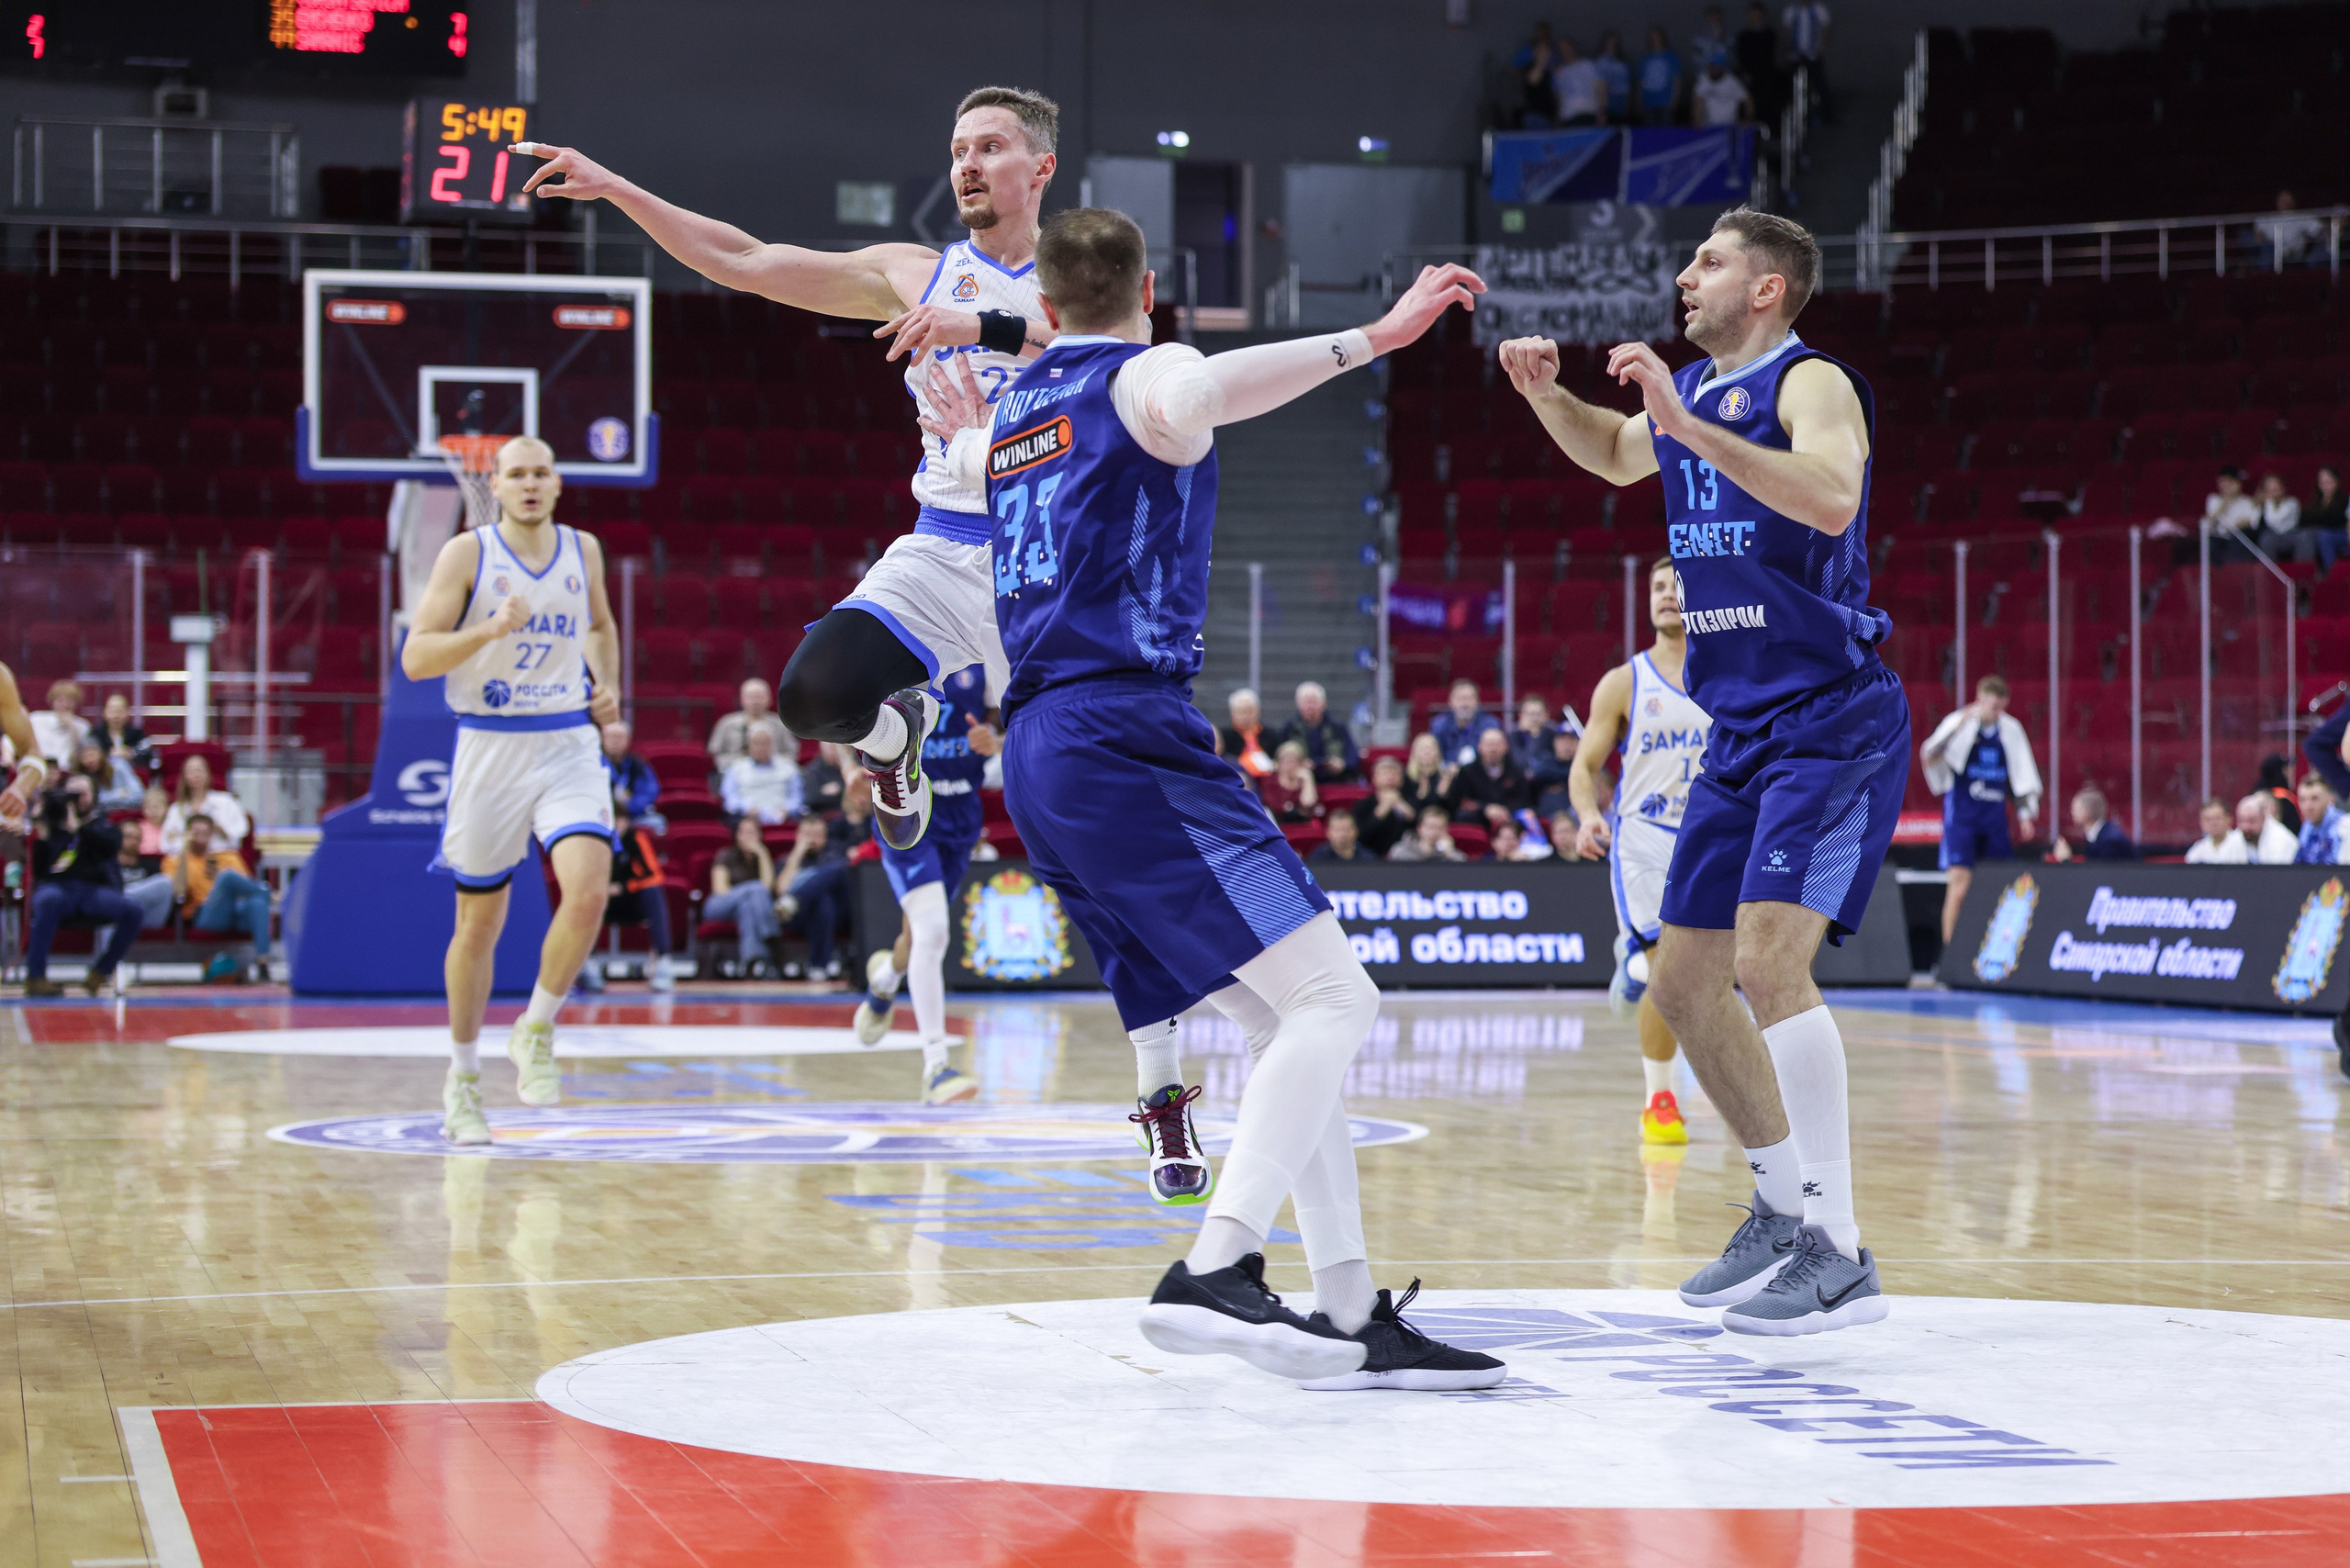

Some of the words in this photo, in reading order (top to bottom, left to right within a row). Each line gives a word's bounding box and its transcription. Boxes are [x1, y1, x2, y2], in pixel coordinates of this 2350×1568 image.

[441, 103, 527, 143] 5:49
[430, 144, 509, 203] 21
[981, 366, 1028, 404] 2
[993, 428, 1058, 472] WINLINE
[1679, 459, 1718, 510] 13
[1669, 521, 1755, 559] ENIT
[1689, 605, 1767, 634] ГАЗПРОМ
[514, 643, 553, 669] 27
[1641, 727, 1710, 754] SAMA
[1762, 865, 1791, 873] KELME
[1325, 890, 1528, 921] тельство
[2086, 885, 2237, 935] Правительство
[1410, 925, 1585, 964] области
[2049, 930, 2161, 983] Самарской
[2155, 936, 2245, 980] области
